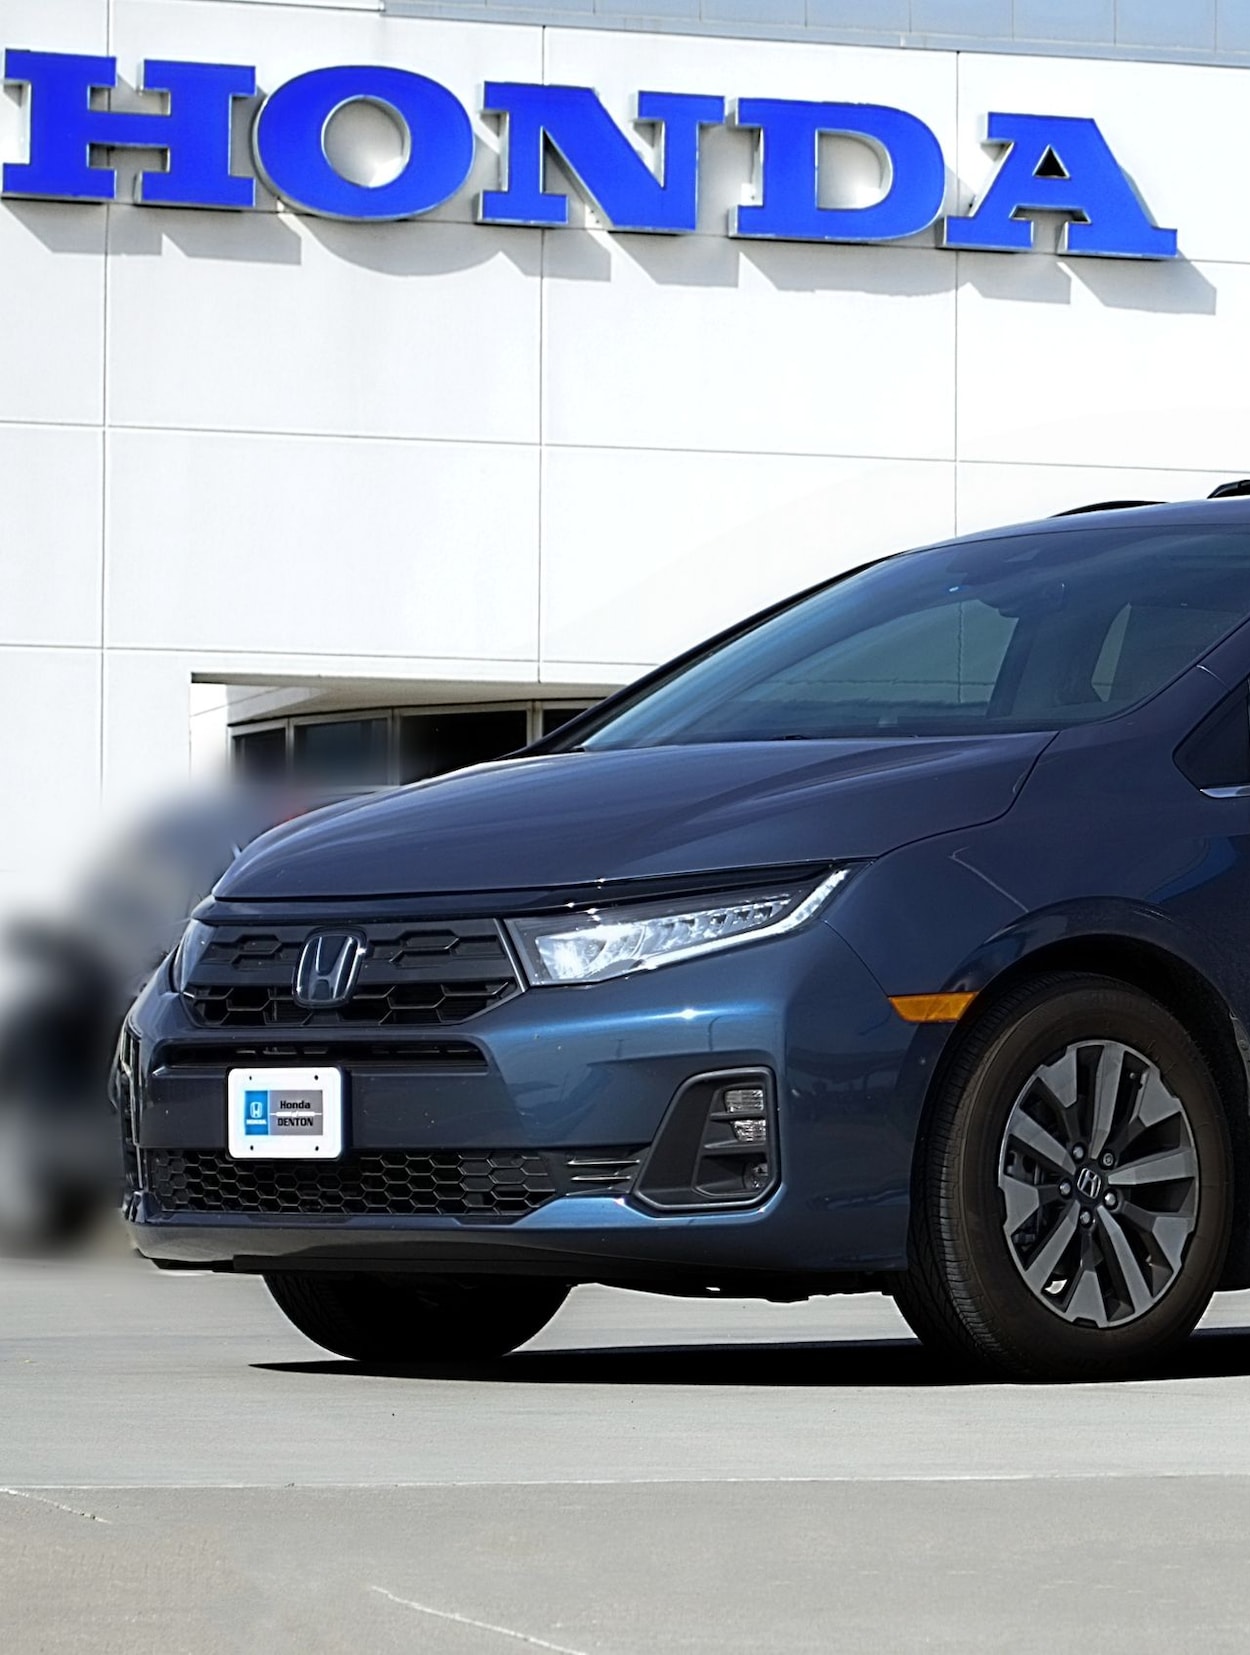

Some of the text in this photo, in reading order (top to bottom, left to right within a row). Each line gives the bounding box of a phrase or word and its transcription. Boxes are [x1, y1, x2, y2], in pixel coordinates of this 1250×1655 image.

[2, 47, 1178, 258] HONDA
[280, 1100, 311, 1109] Honda
[277, 1118, 314, 1127] DENTON
